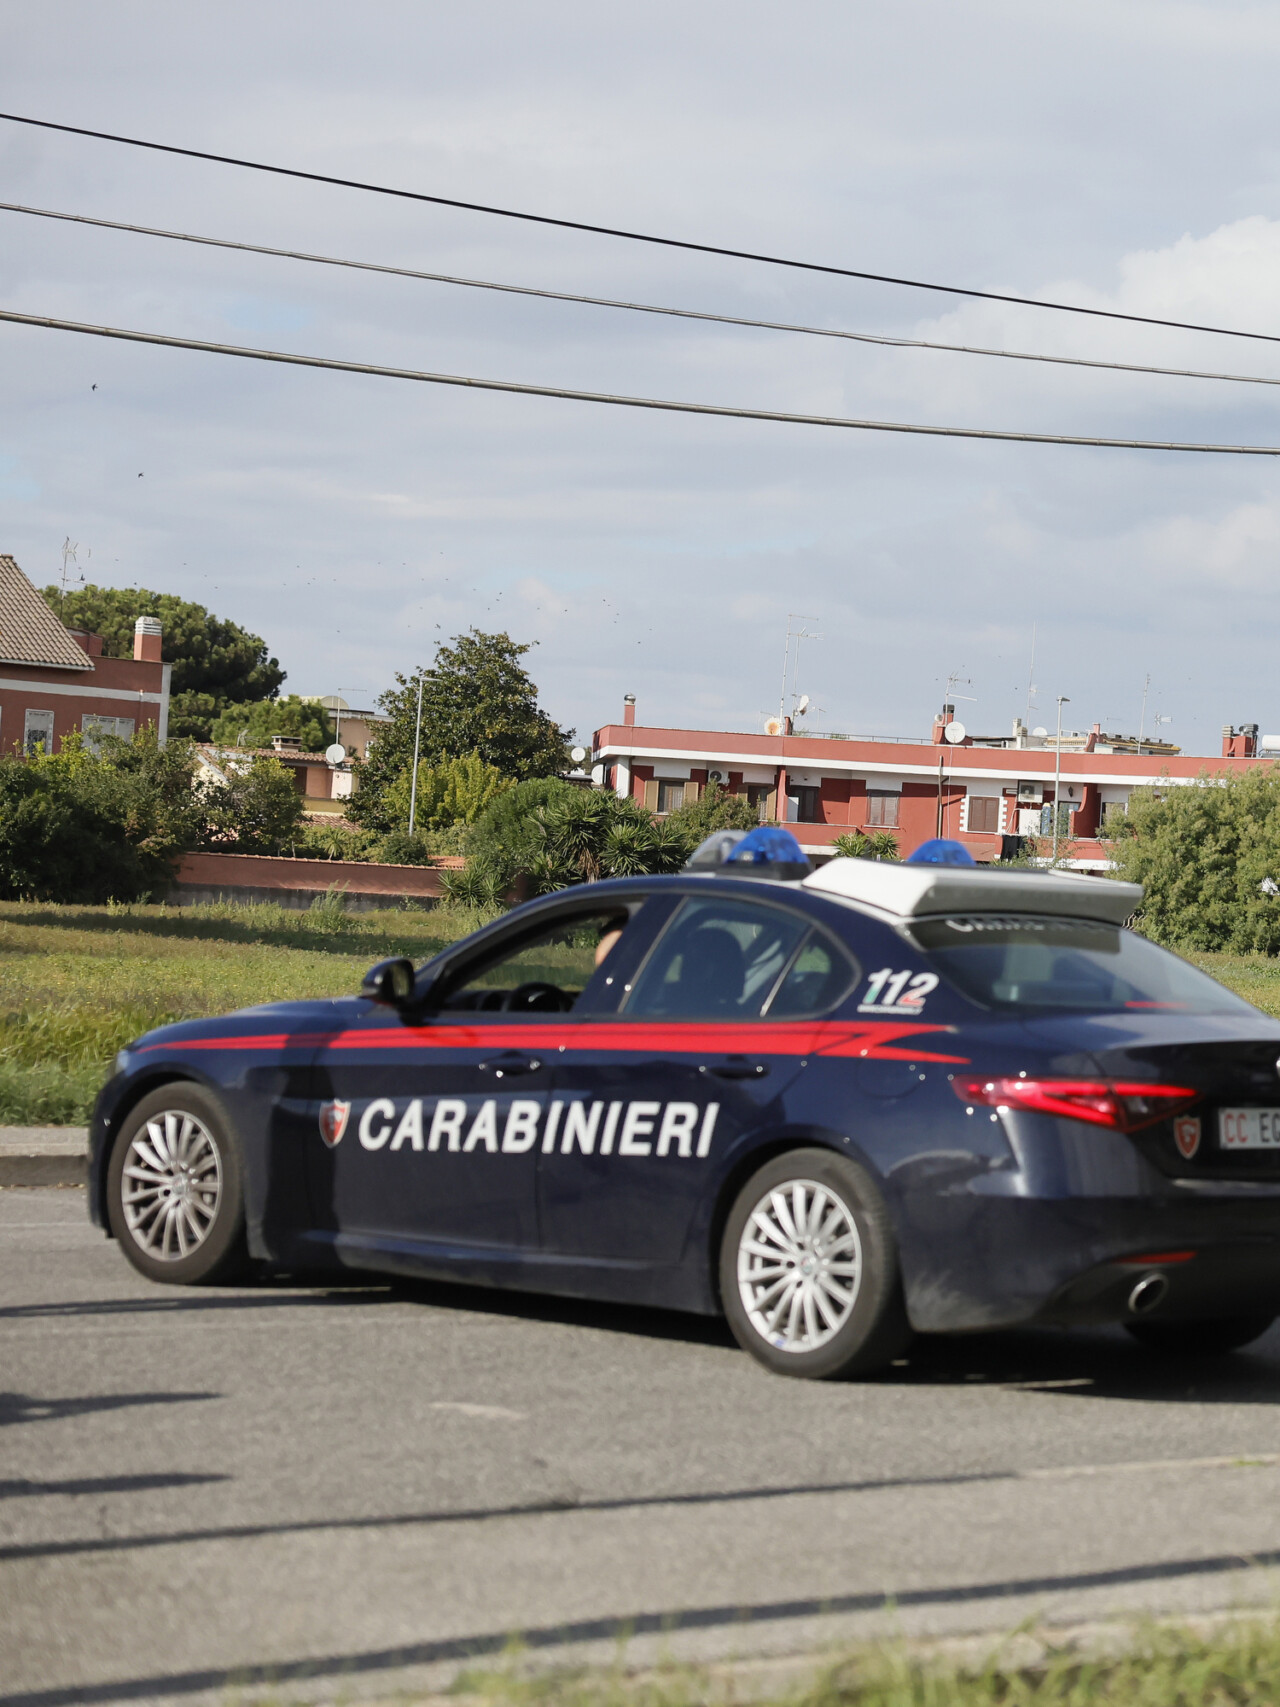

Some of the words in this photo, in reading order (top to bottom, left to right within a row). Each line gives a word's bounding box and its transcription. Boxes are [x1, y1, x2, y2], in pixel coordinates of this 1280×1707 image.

[863, 968, 939, 1006] 112
[358, 1098, 720, 1158] CARABINIERI
[1224, 1113, 1248, 1143] CC
